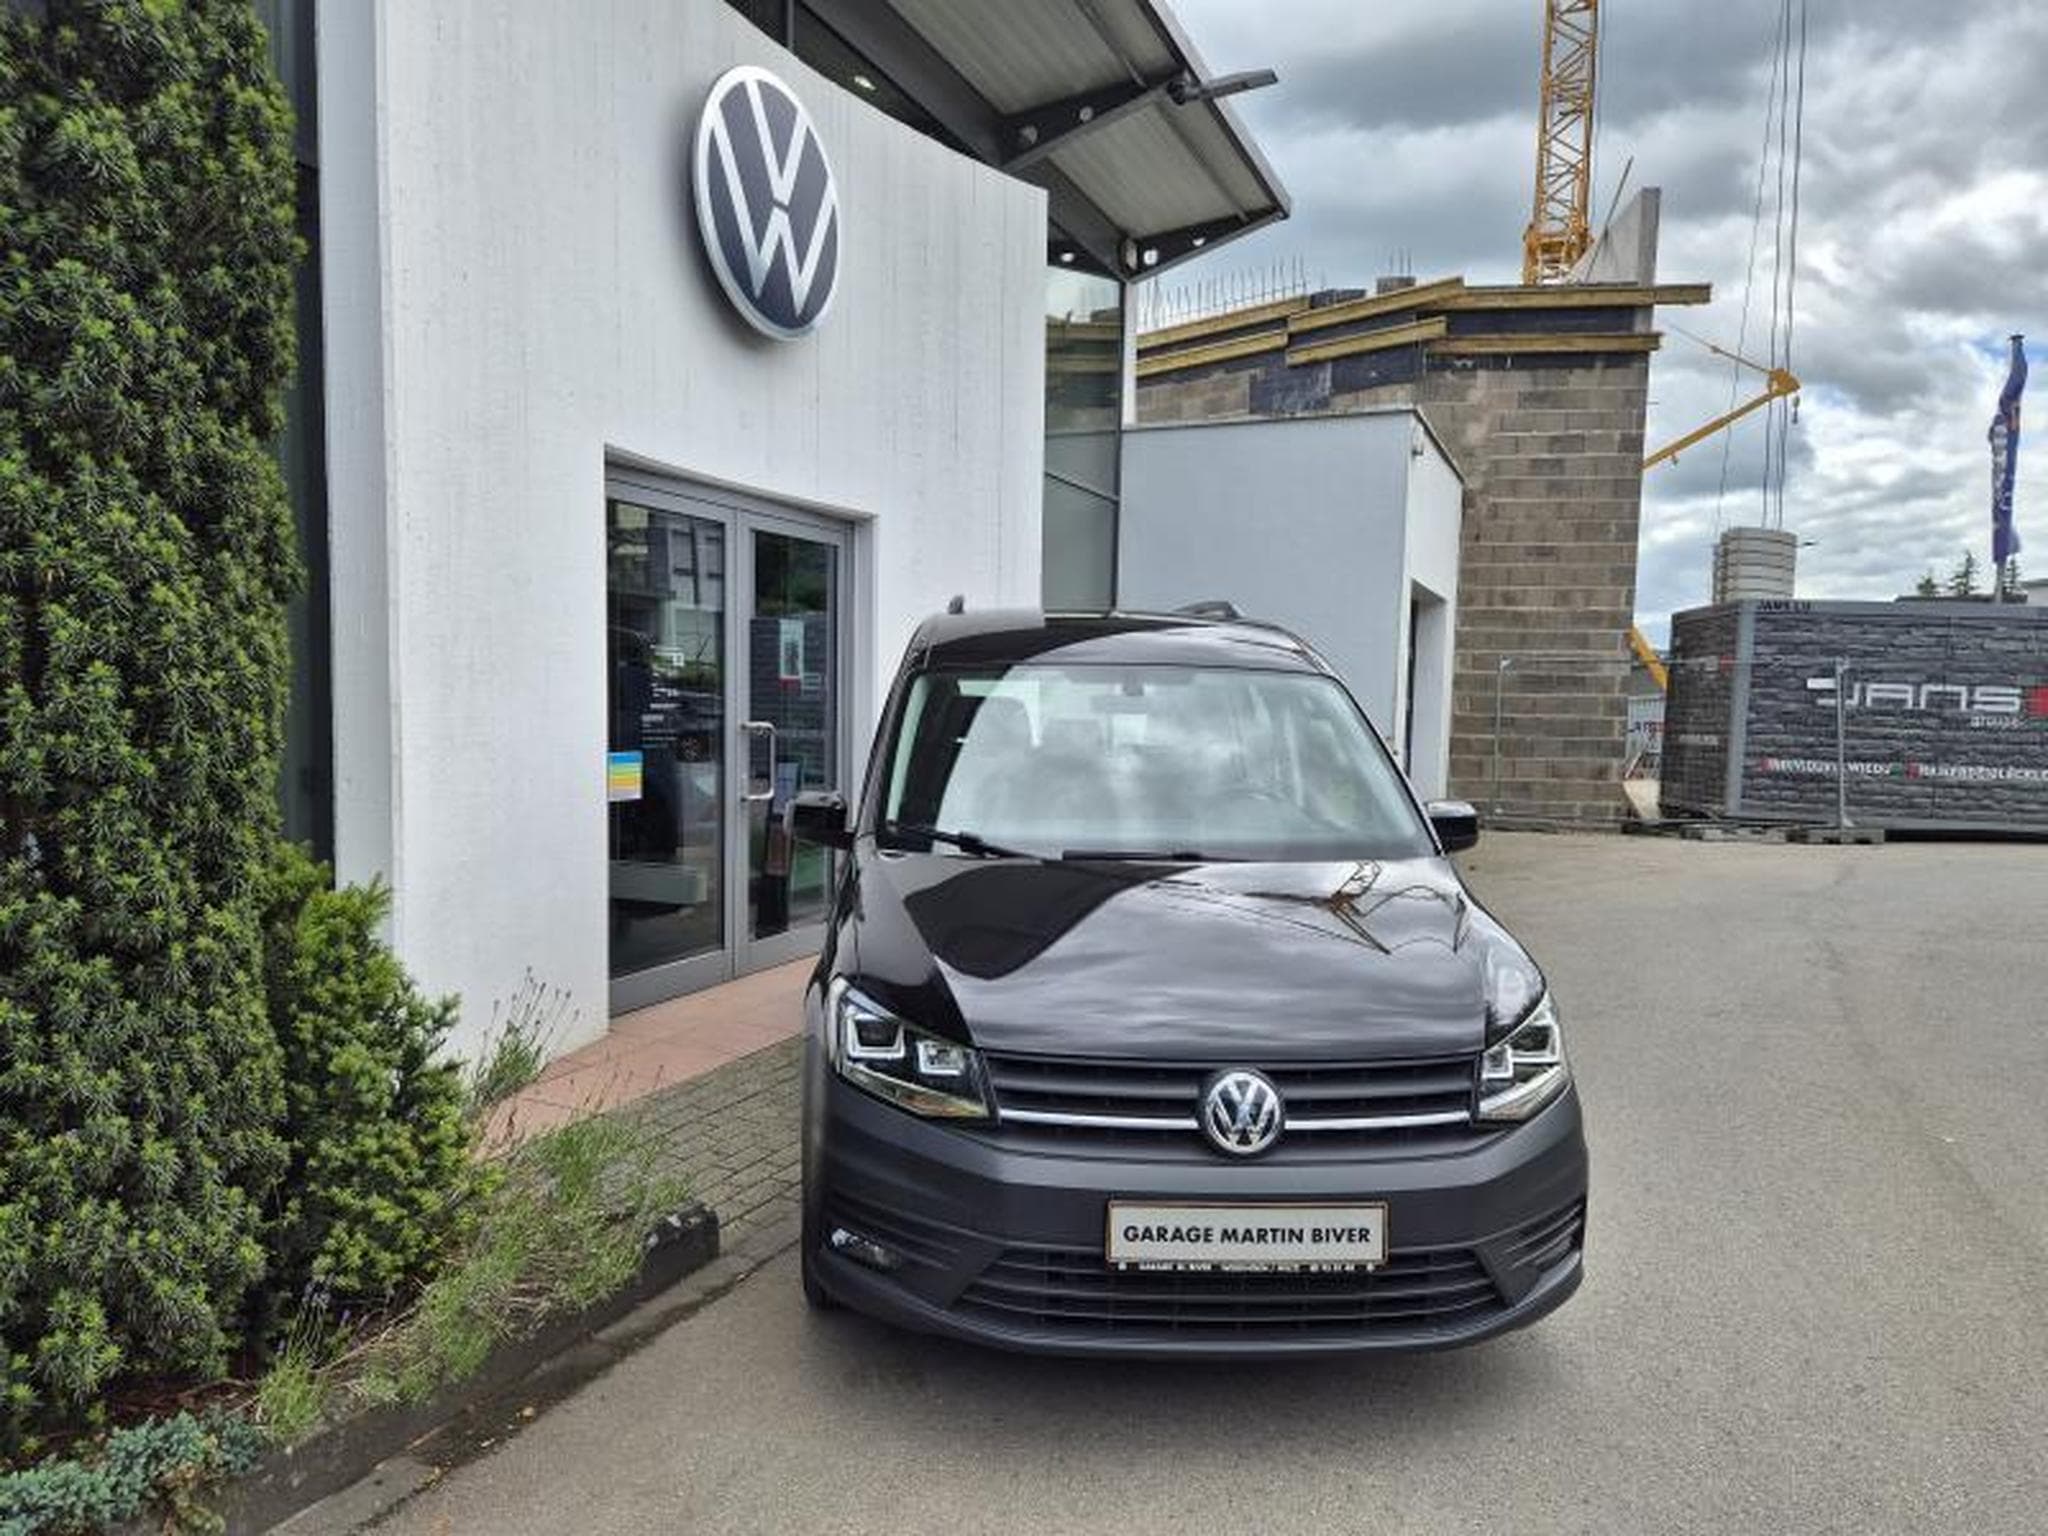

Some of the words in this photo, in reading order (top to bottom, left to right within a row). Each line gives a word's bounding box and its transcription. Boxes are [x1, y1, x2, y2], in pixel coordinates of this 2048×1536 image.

[698, 70, 839, 330] VW
[1206, 1072, 1280, 1153] VW
[1123, 1225, 1214, 1244] GARAGE
[1220, 1227, 1304, 1245] MARTIN
[1311, 1228, 1371, 1244] BIVER
